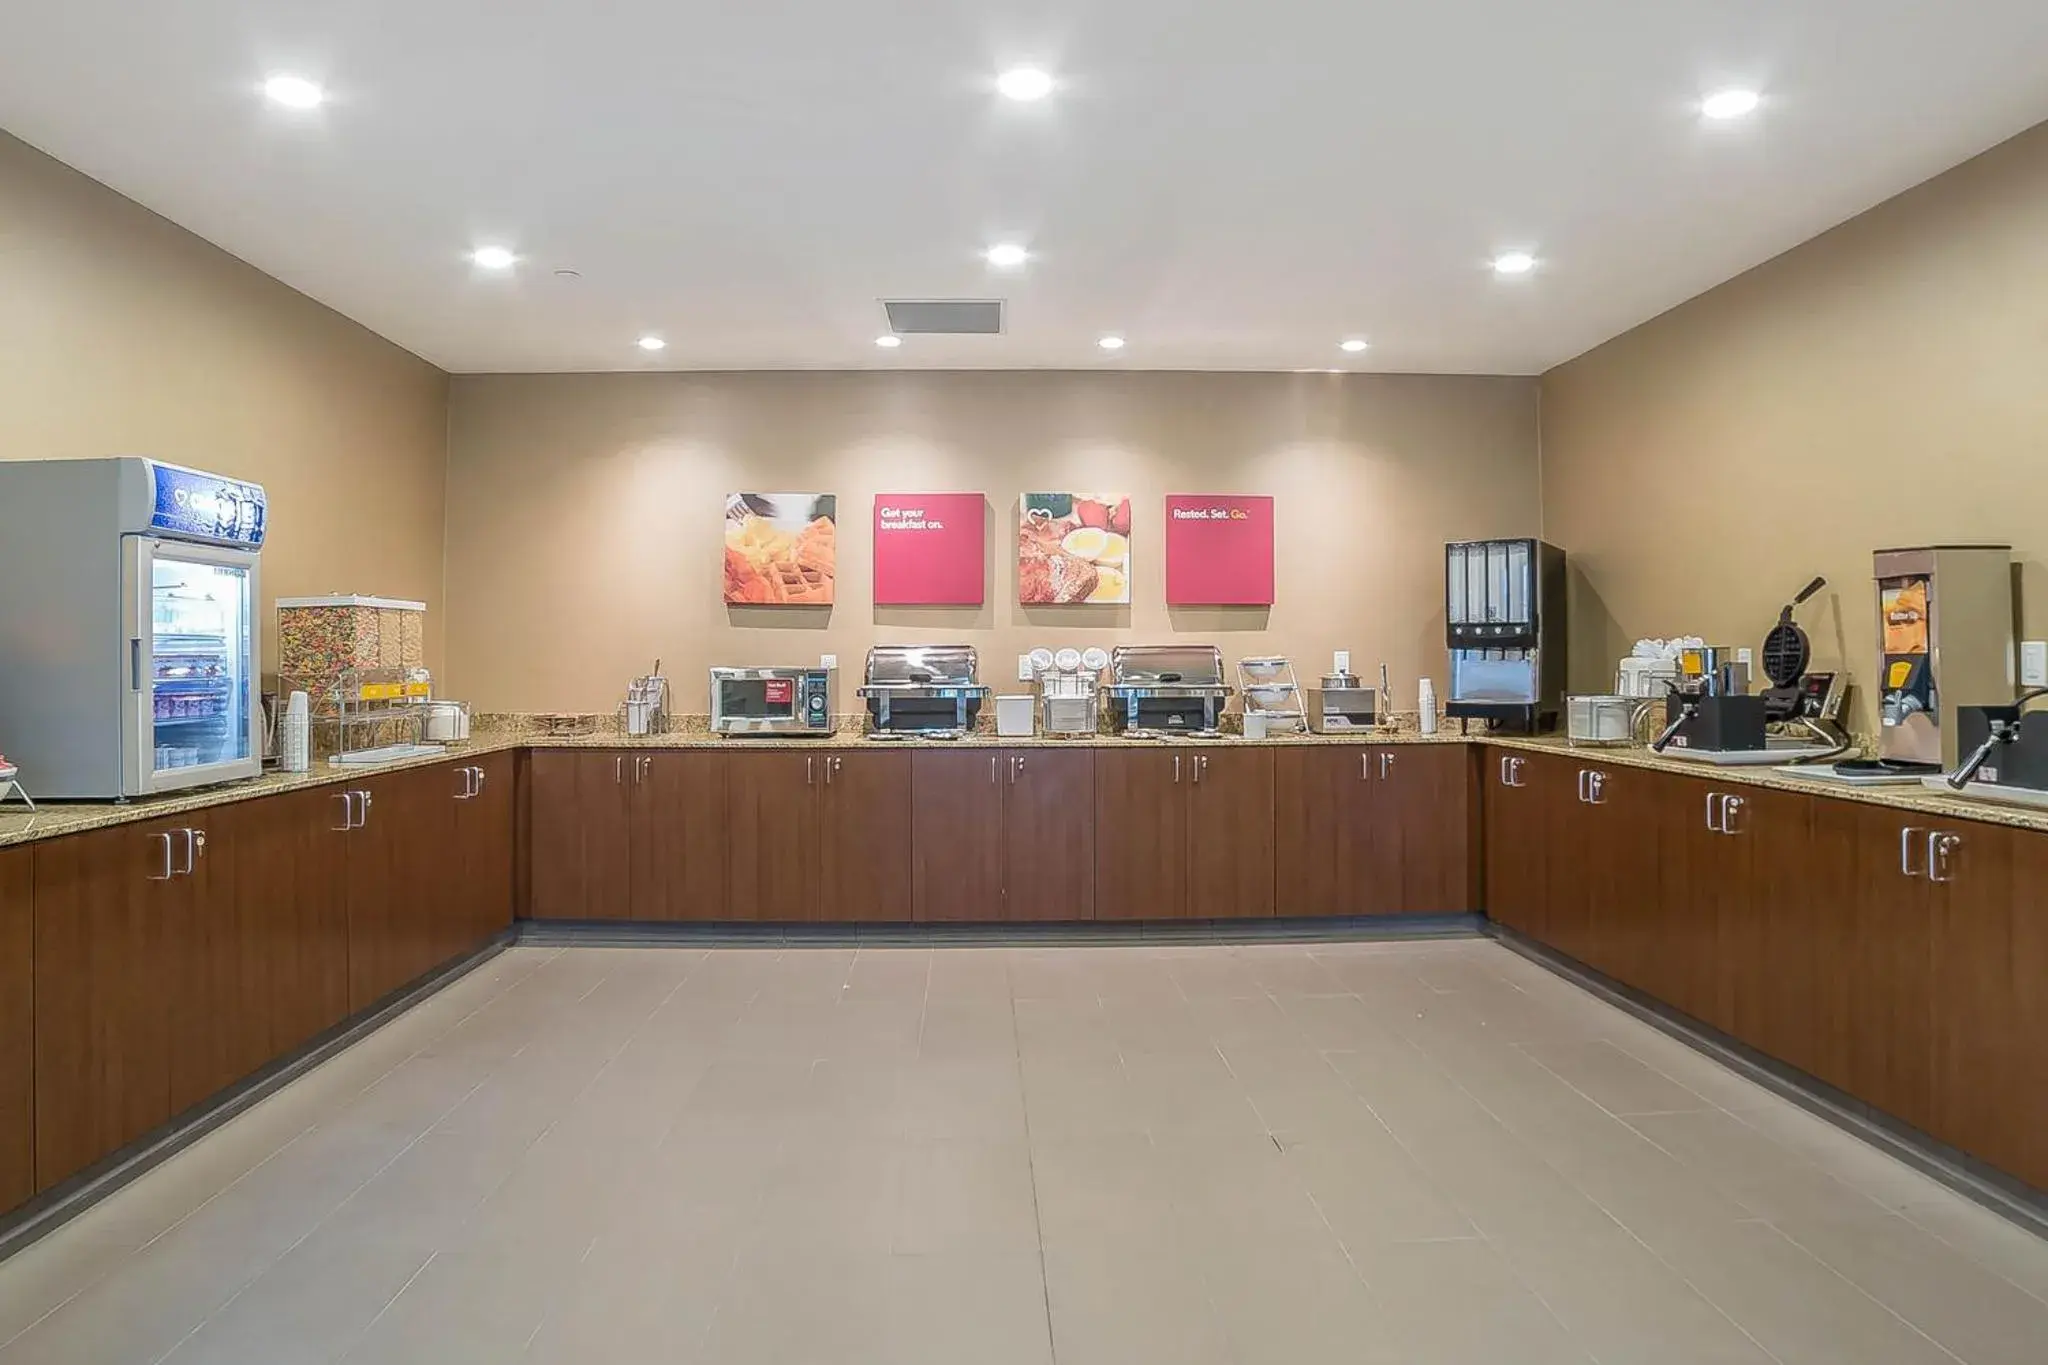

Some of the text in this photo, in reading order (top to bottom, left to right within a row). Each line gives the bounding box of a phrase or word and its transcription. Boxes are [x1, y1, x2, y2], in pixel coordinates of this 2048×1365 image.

[881, 507, 901, 518] Get
[1173, 509, 1209, 520] Rested.
[1211, 509, 1229, 519] Set.
[881, 520, 944, 529] breakfast on.
